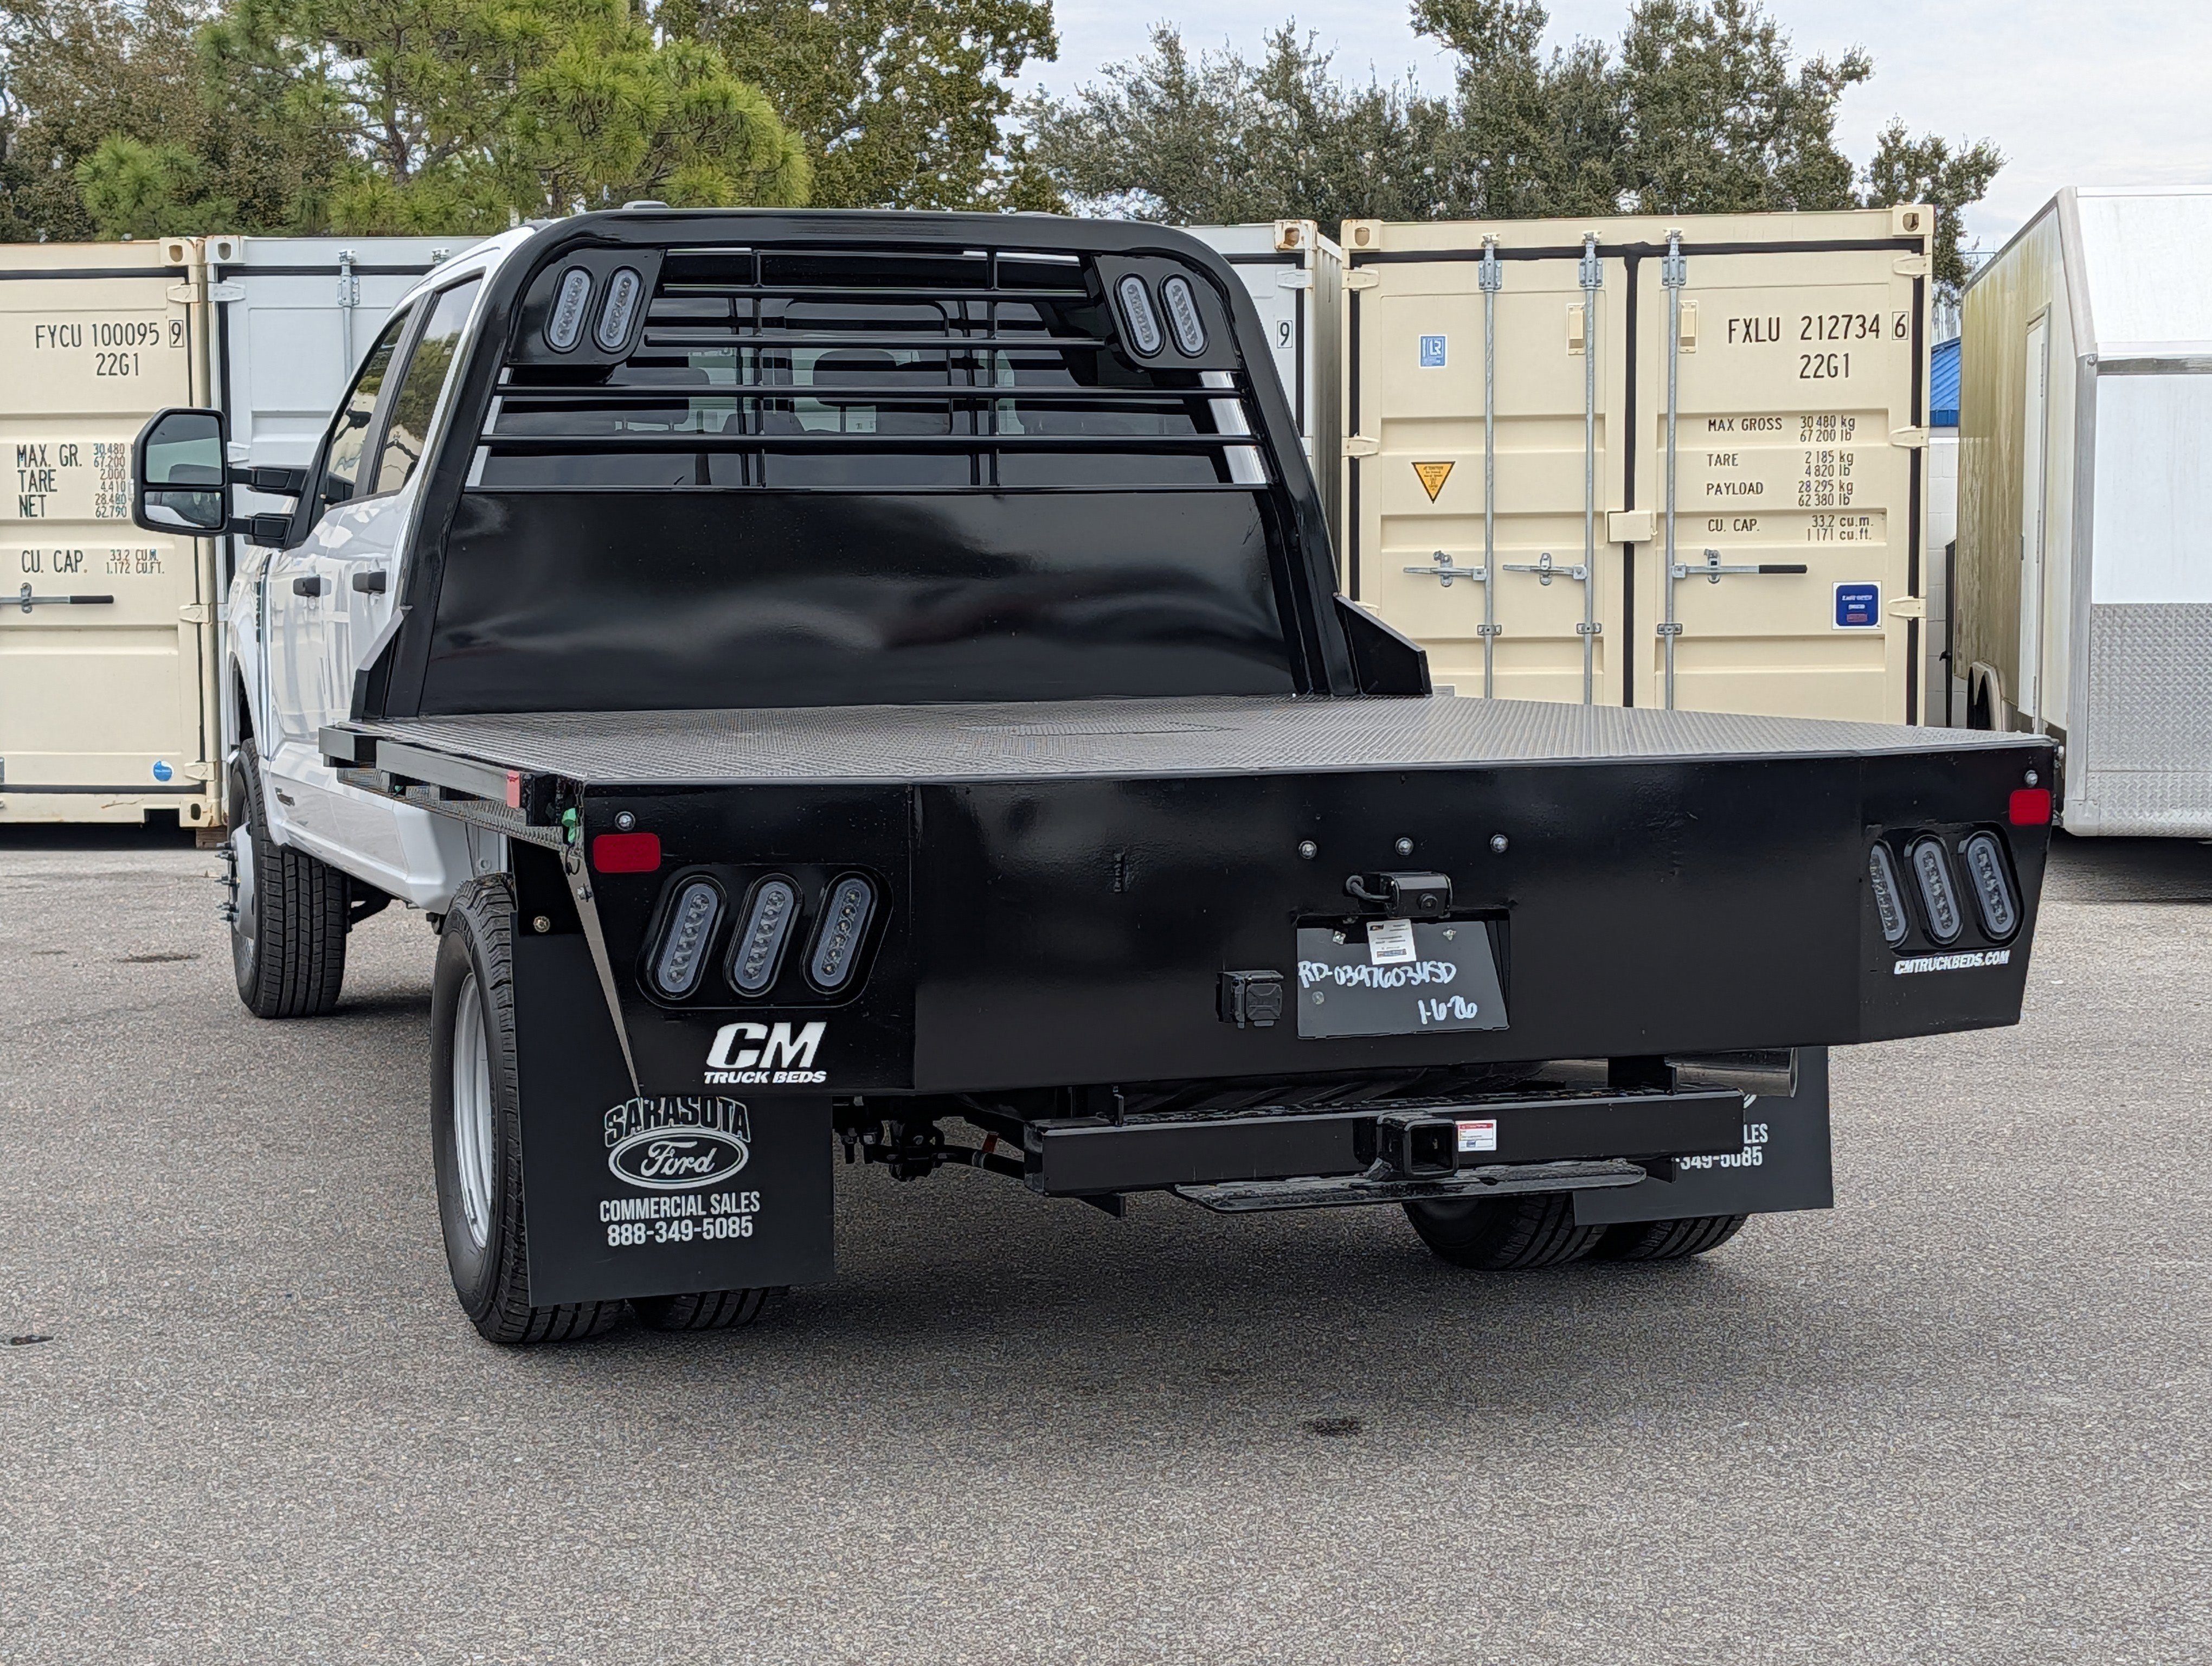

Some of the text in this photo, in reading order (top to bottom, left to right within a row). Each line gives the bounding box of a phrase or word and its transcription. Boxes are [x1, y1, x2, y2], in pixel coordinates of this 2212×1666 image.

[35, 322, 182, 349] FYCU 100095 9
[1279, 322, 1290, 346] 9
[1728, 313, 1906, 344] FXLU 212734 6
[95, 353, 139, 376] 22G1
[1799, 353, 1849, 379] 22G1
[1708, 416, 1782, 432] MAX GROSS
[1841, 414, 1855, 432] kg
[1840, 429, 1854, 442] lb
[16, 444, 82, 468] MAX. GR.
[1707, 453, 1739, 467] TARE
[1839, 450, 1854, 467] kg
[17, 469, 57, 493] TARE
[1839, 464, 1851, 477] lb
[1706, 482, 1764, 496] PAYLOAD
[1838, 479, 1854, 496] kg
[18, 494, 47, 518] NET
[1839, 494, 1850, 506] lb
[1708, 518, 1759, 532] CU. CAP.
[1839, 527, 1872, 541] cu.ft.
[1840, 517, 1873, 529] cu.m.
[21, 549, 87, 573] CU. CAP.
[1894, 950, 2010, 975] CMTRUCKBEDS.COM
[706, 1022, 827, 1069] CM
[704, 1071, 827, 1084] TRUCK BEDS
[605, 1096, 751, 1148] SARASOTA
[641, 1141, 718, 1176] Ford
[600, 1191, 760, 1222] COMMERCIAL SALES
[607, 1216, 753, 1246] 888-349-5085
